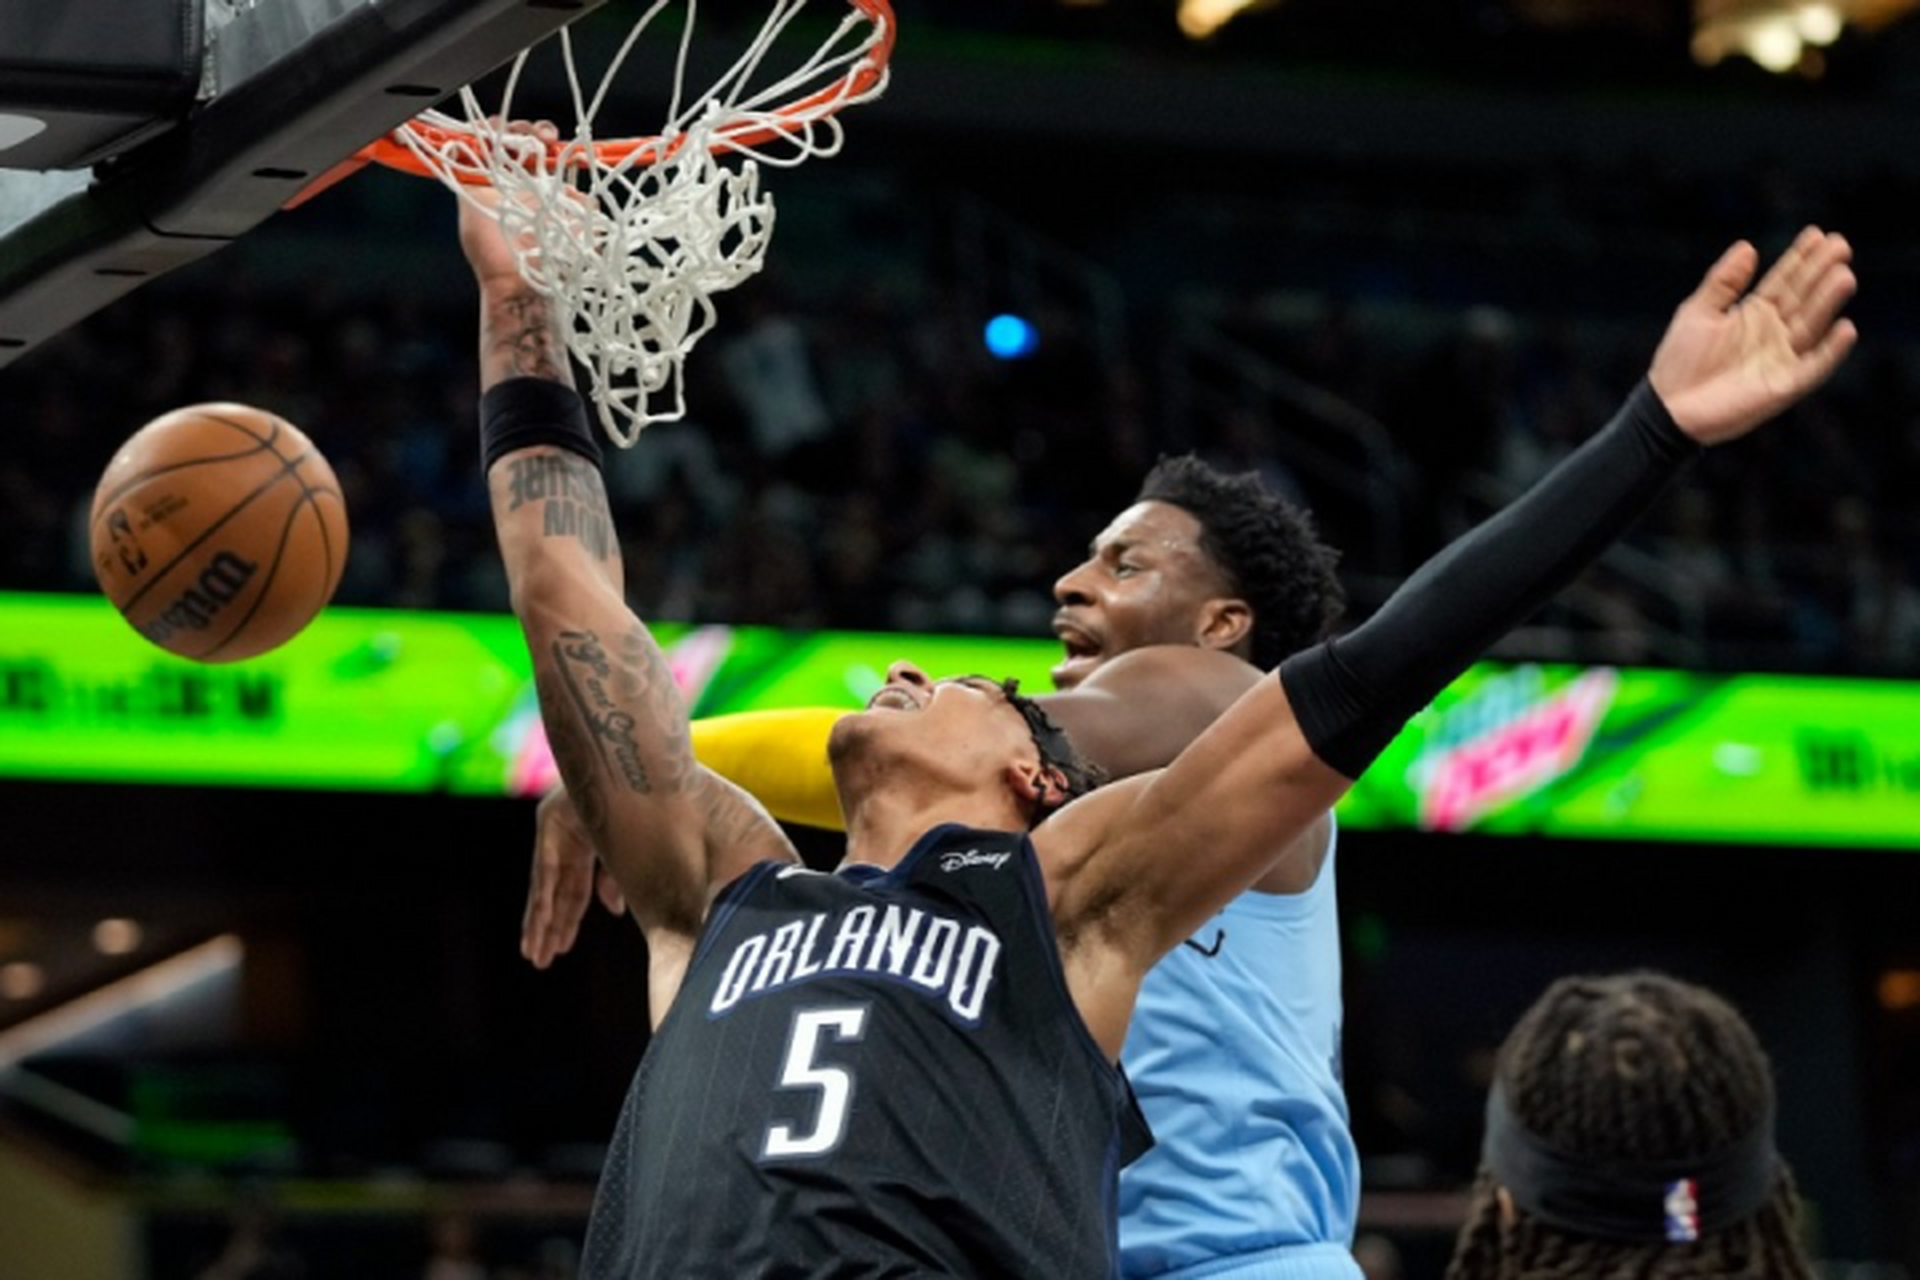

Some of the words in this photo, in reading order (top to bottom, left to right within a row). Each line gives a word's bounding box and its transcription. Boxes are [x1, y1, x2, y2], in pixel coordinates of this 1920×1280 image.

[940, 848, 1012, 873] Disney
[709, 904, 1001, 1022] ORLANDO
[763, 1006, 867, 1158] 5
